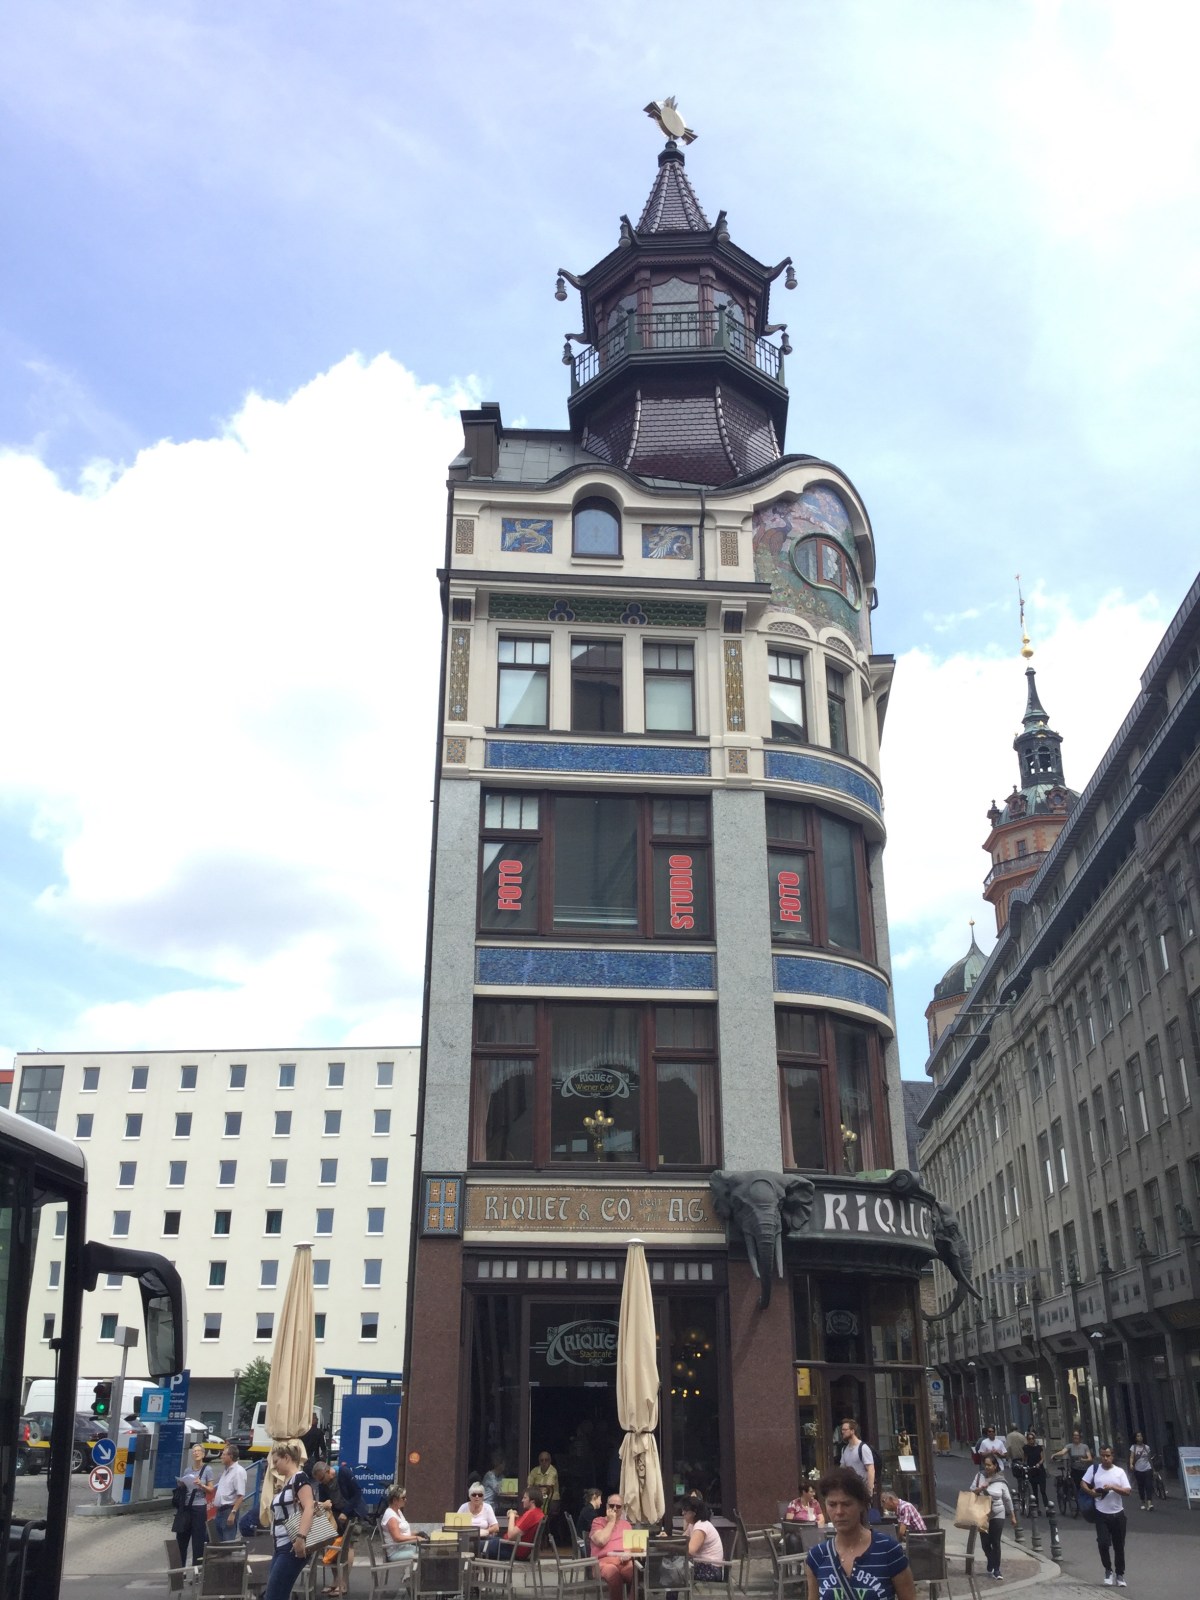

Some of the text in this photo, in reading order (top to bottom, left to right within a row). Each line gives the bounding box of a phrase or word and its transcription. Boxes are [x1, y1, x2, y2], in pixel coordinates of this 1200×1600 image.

[498, 859, 523, 911] FOTO
[669, 854, 695, 930] STUDIO
[778, 871, 802, 923] FOTO
[563, 1332, 617, 1351] RIQUE
[358, 1417, 393, 1464] P
